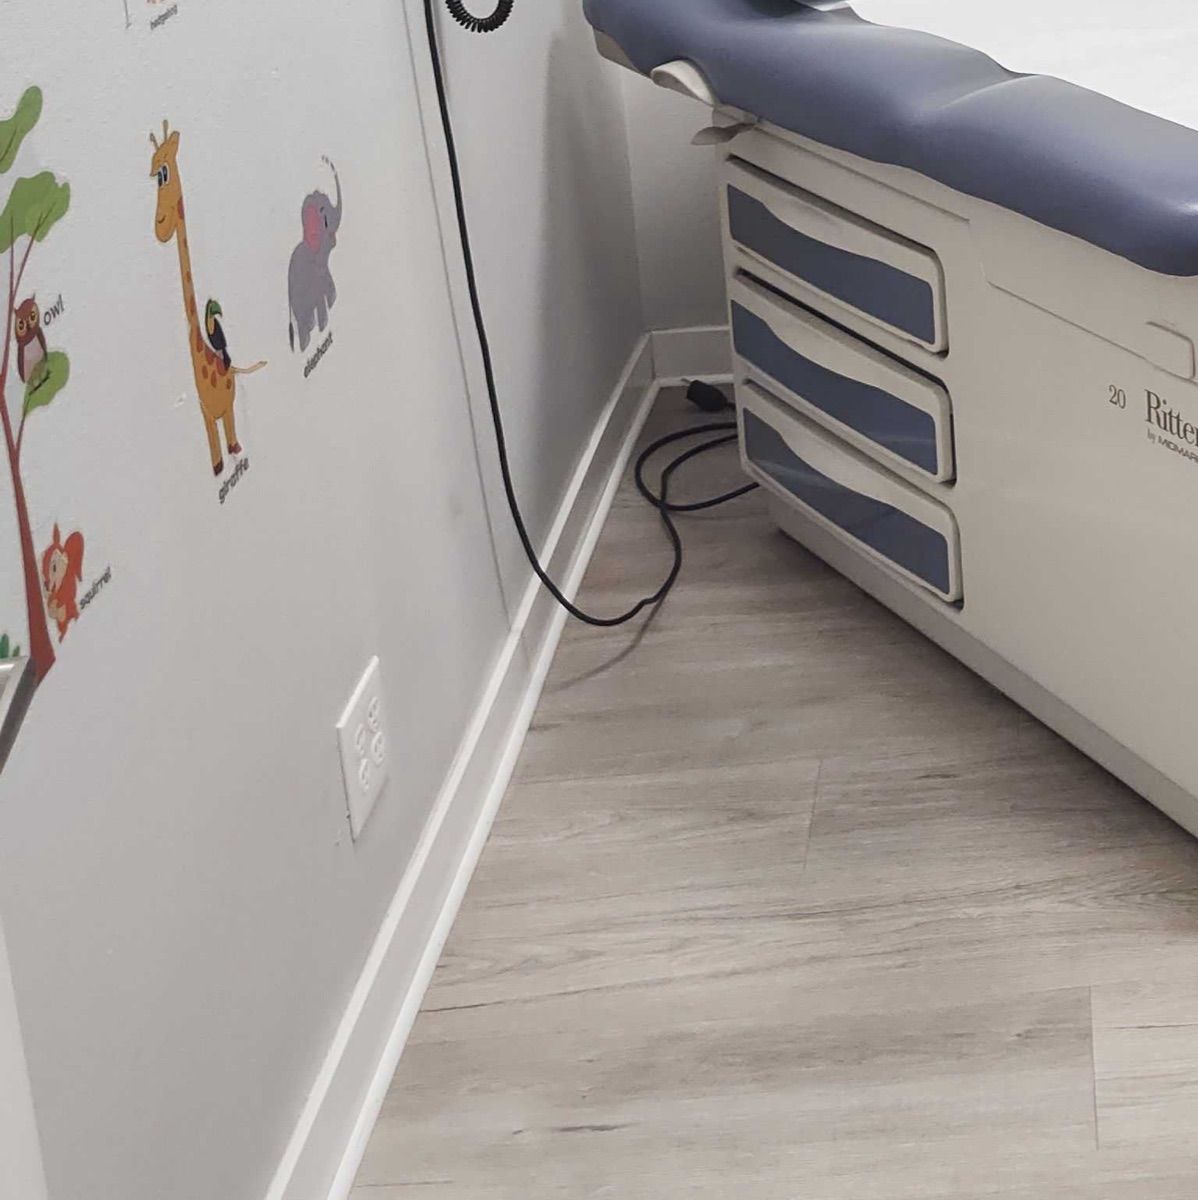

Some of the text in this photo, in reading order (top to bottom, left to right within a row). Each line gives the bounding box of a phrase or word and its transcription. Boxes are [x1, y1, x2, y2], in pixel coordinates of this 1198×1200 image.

[43, 294, 65, 326] owl
[304, 331, 333, 378] elephant
[1108, 384, 1126, 409] 20
[218, 457, 249, 504] giraffe
[80, 566, 111, 610] squirrel
